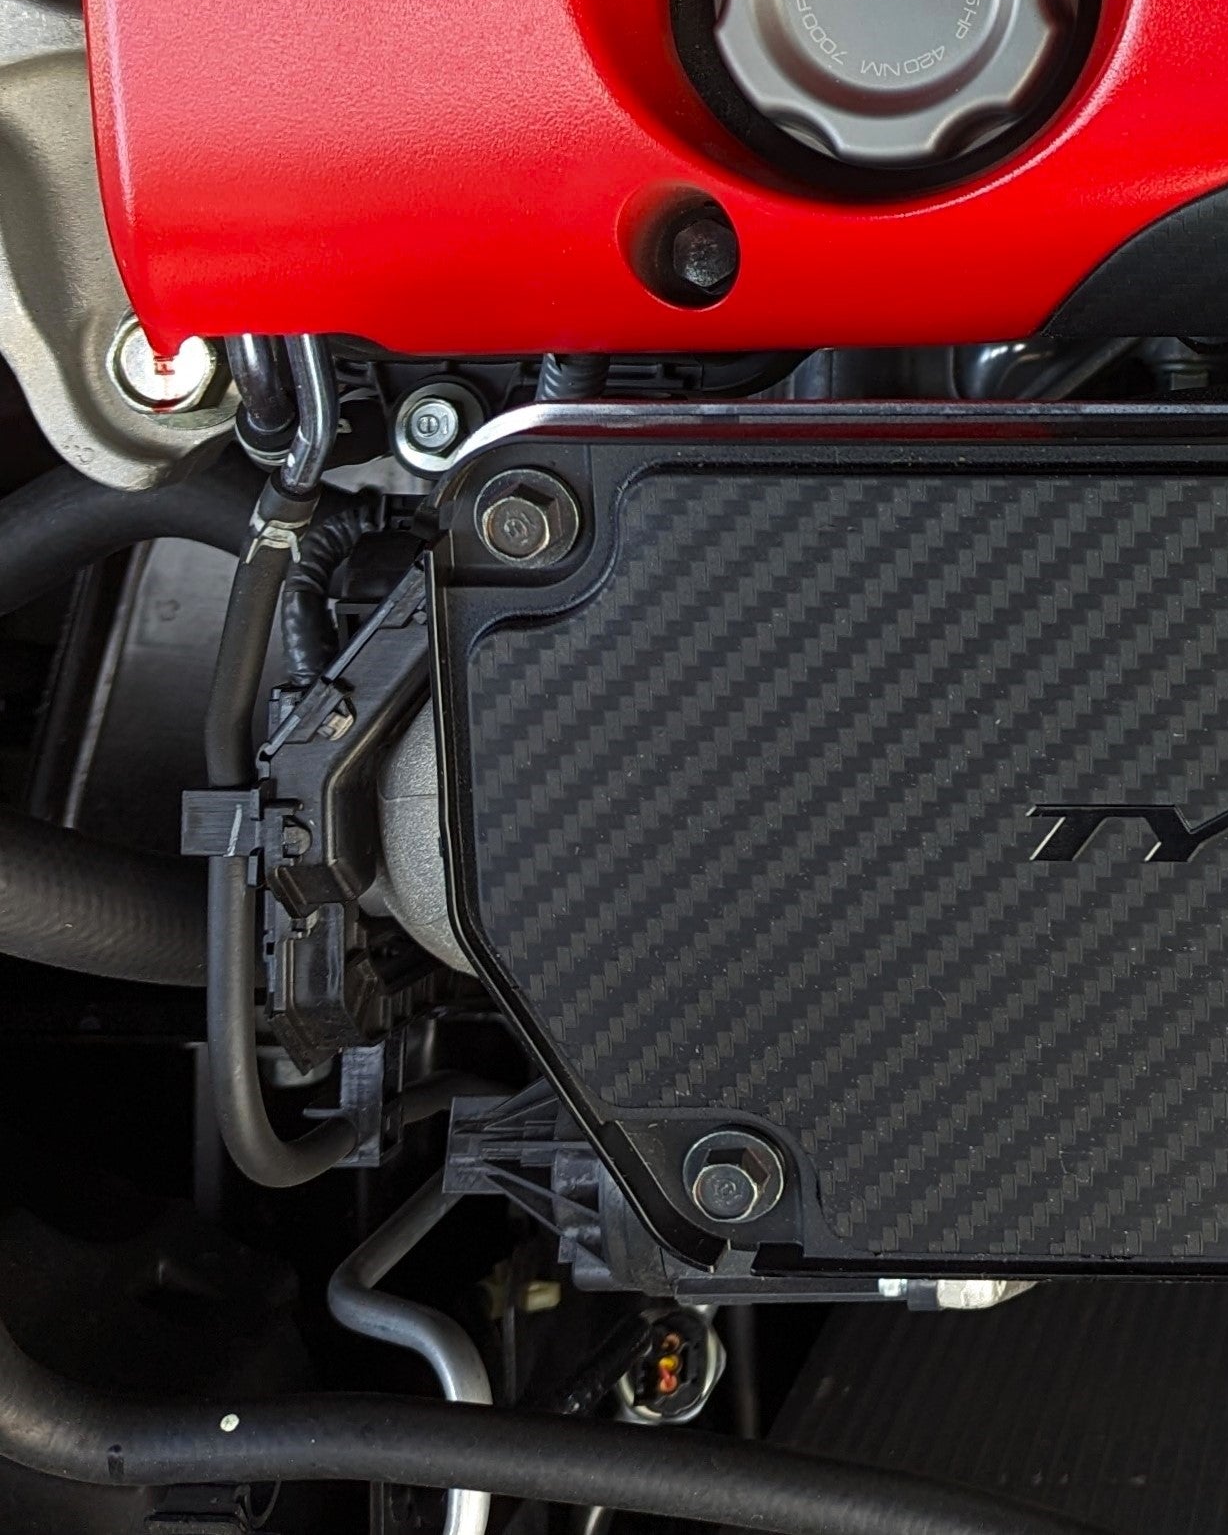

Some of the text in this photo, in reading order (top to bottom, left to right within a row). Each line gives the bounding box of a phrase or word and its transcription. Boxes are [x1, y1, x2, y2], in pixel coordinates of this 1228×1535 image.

[803, 12, 848, 65] 7000
[955, 6, 977, 40] HP
[860, 44, 946, 77] 420 NM
